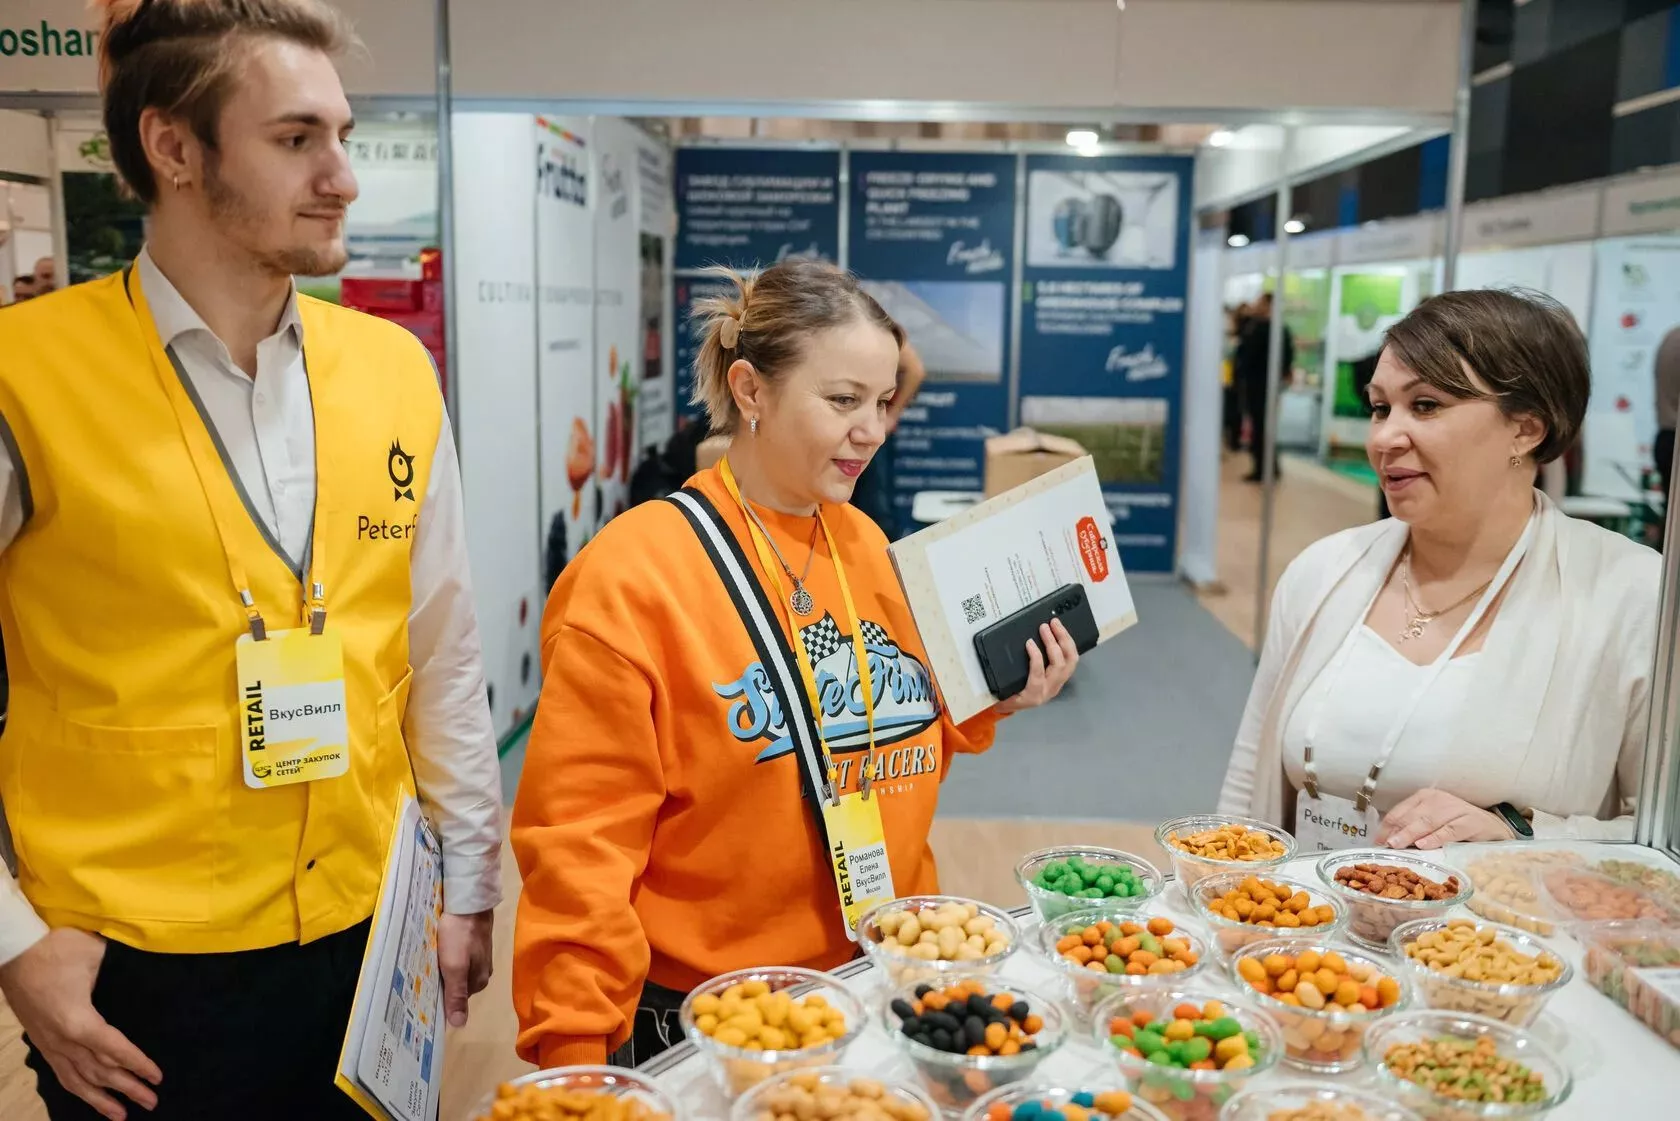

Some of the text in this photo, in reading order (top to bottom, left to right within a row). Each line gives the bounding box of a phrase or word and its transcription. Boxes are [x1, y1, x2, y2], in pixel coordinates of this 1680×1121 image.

[246, 680, 265, 751] RETAIL
[270, 703, 340, 720] ВкусВилл
[275, 753, 341, 768] ЦЕНТР ЗАКУПОК
[1304, 808, 1368, 837] Peterfood
[849, 847, 885, 865] Романова
[834, 841, 854, 907] RETAIL
[859, 862, 879, 874] Елена
[855, 873, 887, 888] ВкусВилл
